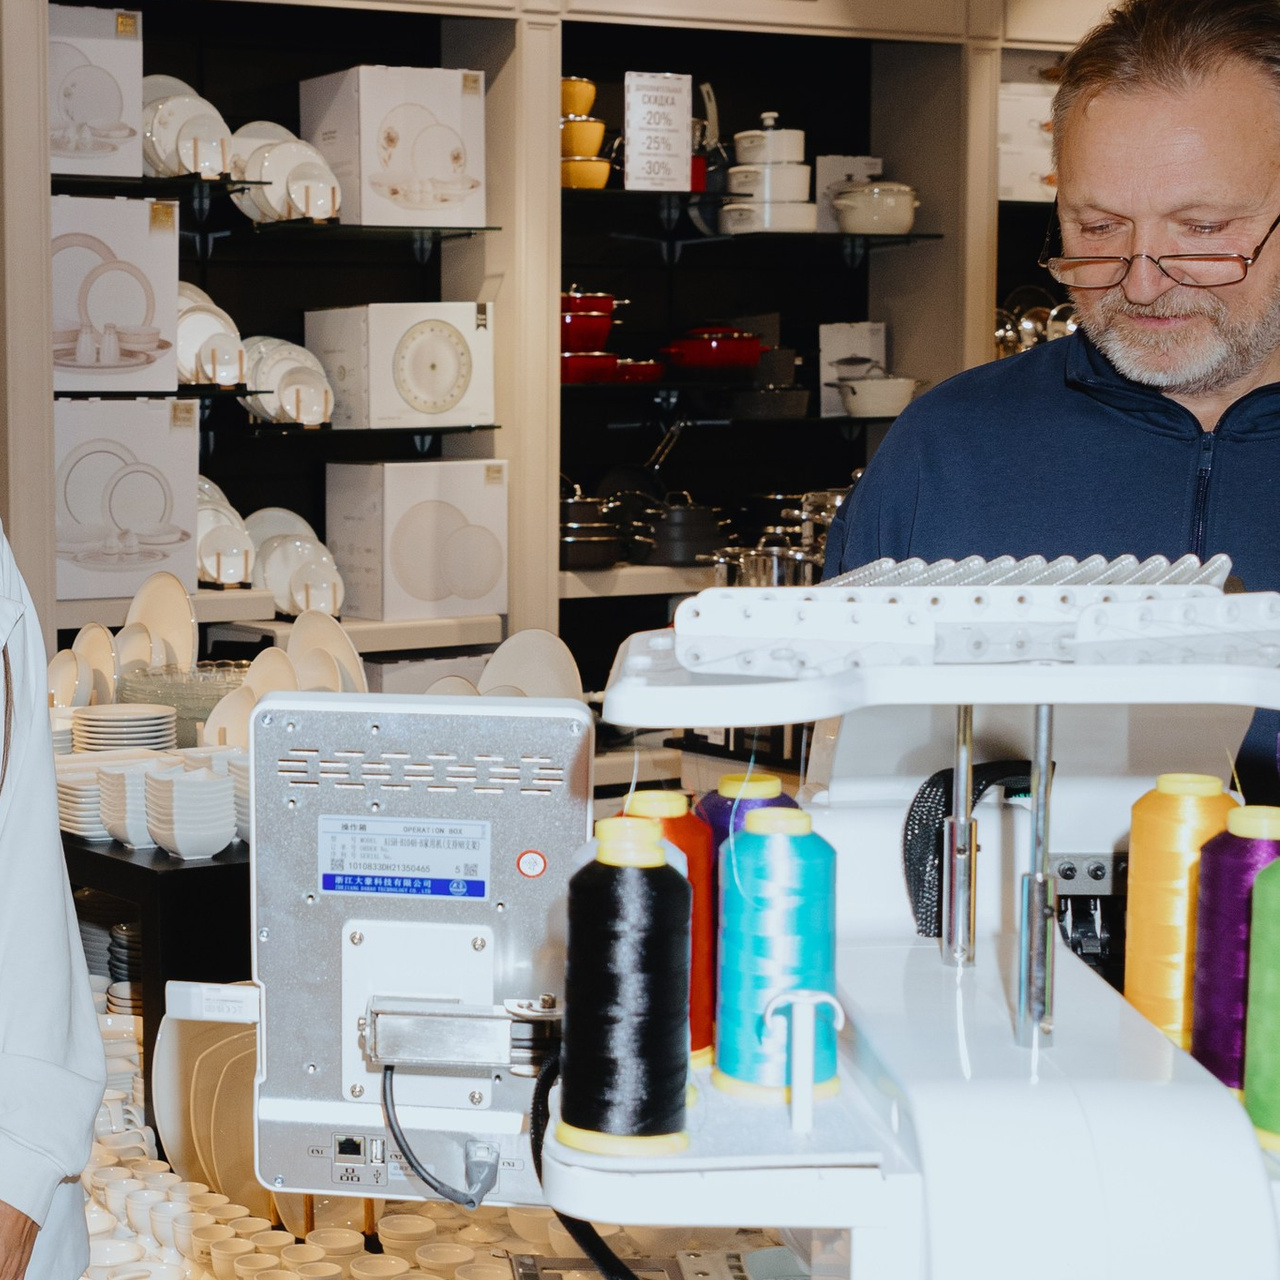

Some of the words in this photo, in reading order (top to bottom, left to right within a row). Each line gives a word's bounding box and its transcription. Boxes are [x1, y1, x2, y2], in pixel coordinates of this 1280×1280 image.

[642, 94, 676, 106] СКИДКА
[643, 111, 672, 126] -20%
[642, 136, 671, 151] -25%
[641, 161, 671, 176] -30%
[403, 826, 444, 835] OPERATION
[311, 1148, 324, 1156] CN1
